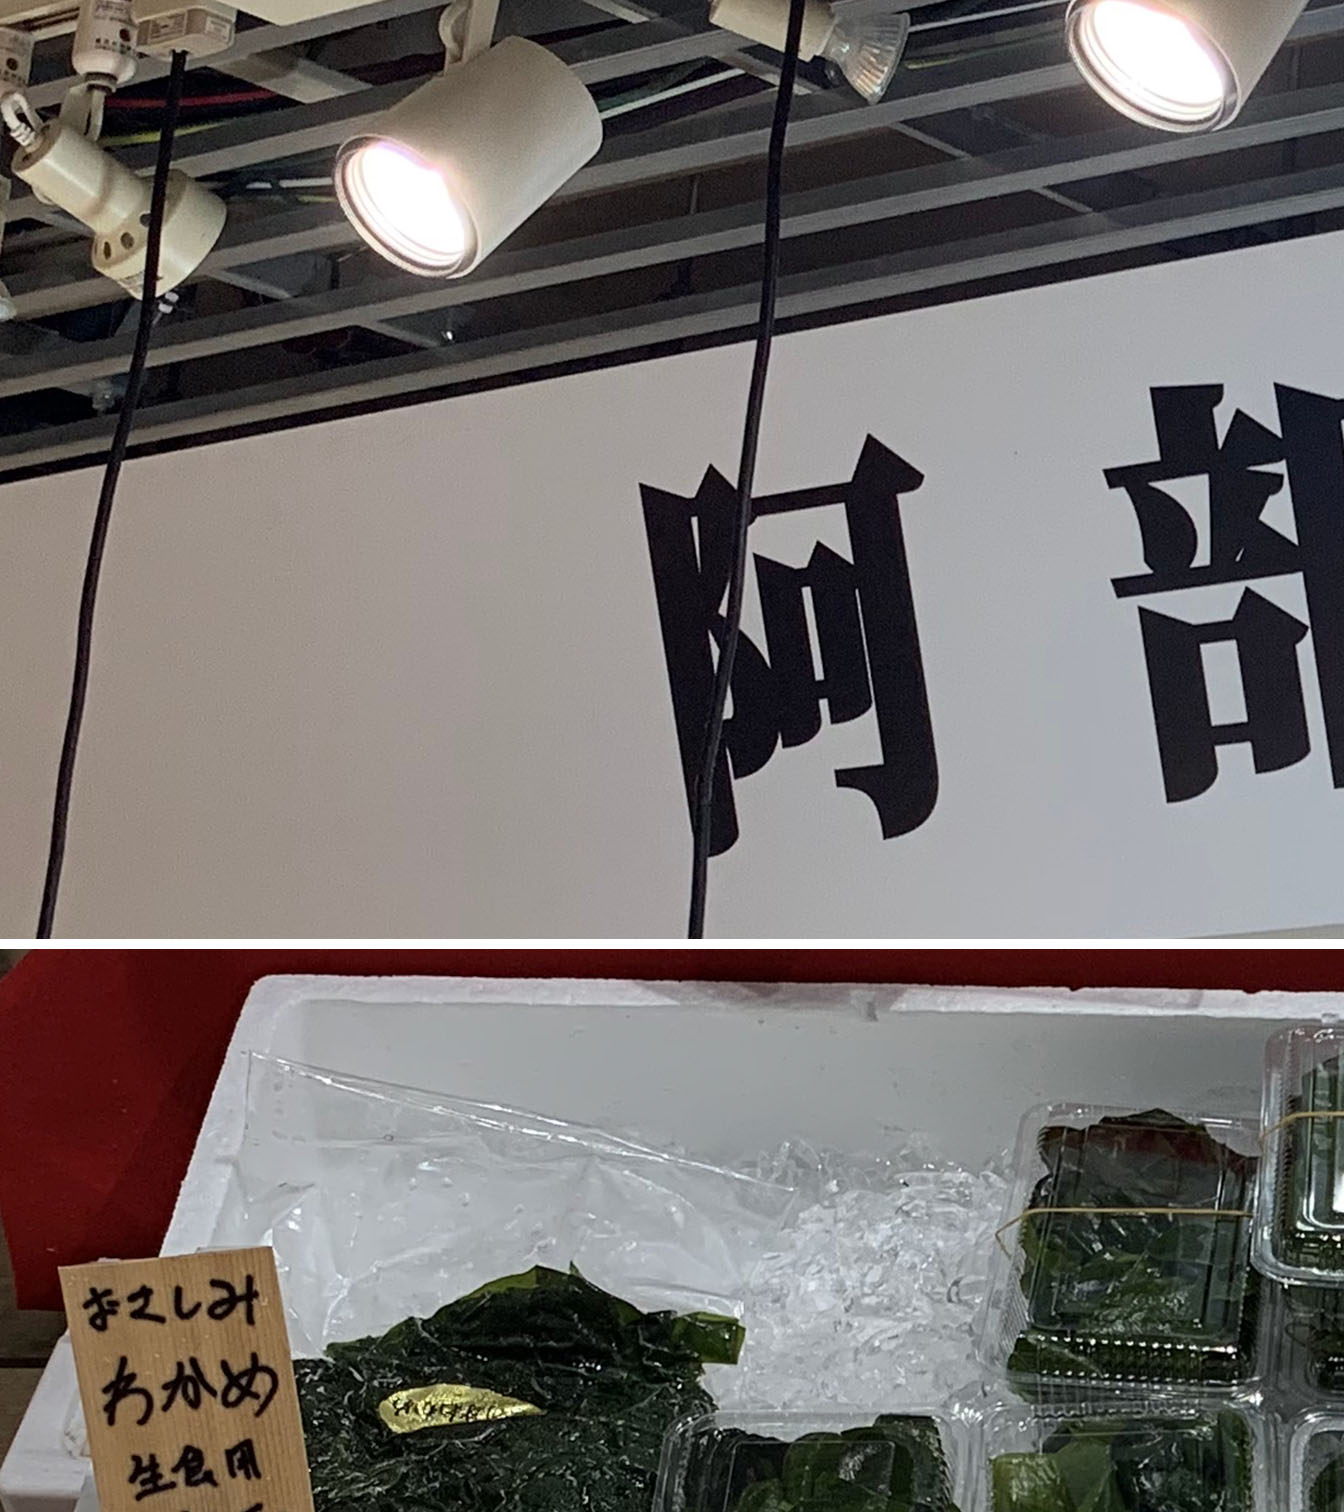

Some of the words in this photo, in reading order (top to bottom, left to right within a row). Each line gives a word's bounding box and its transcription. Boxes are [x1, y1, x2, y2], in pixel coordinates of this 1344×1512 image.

[83, 1274, 260, 1331] おさしみ
[101, 1352, 279, 1426] わかめ
[128, 1438, 262, 1500] 生食用
